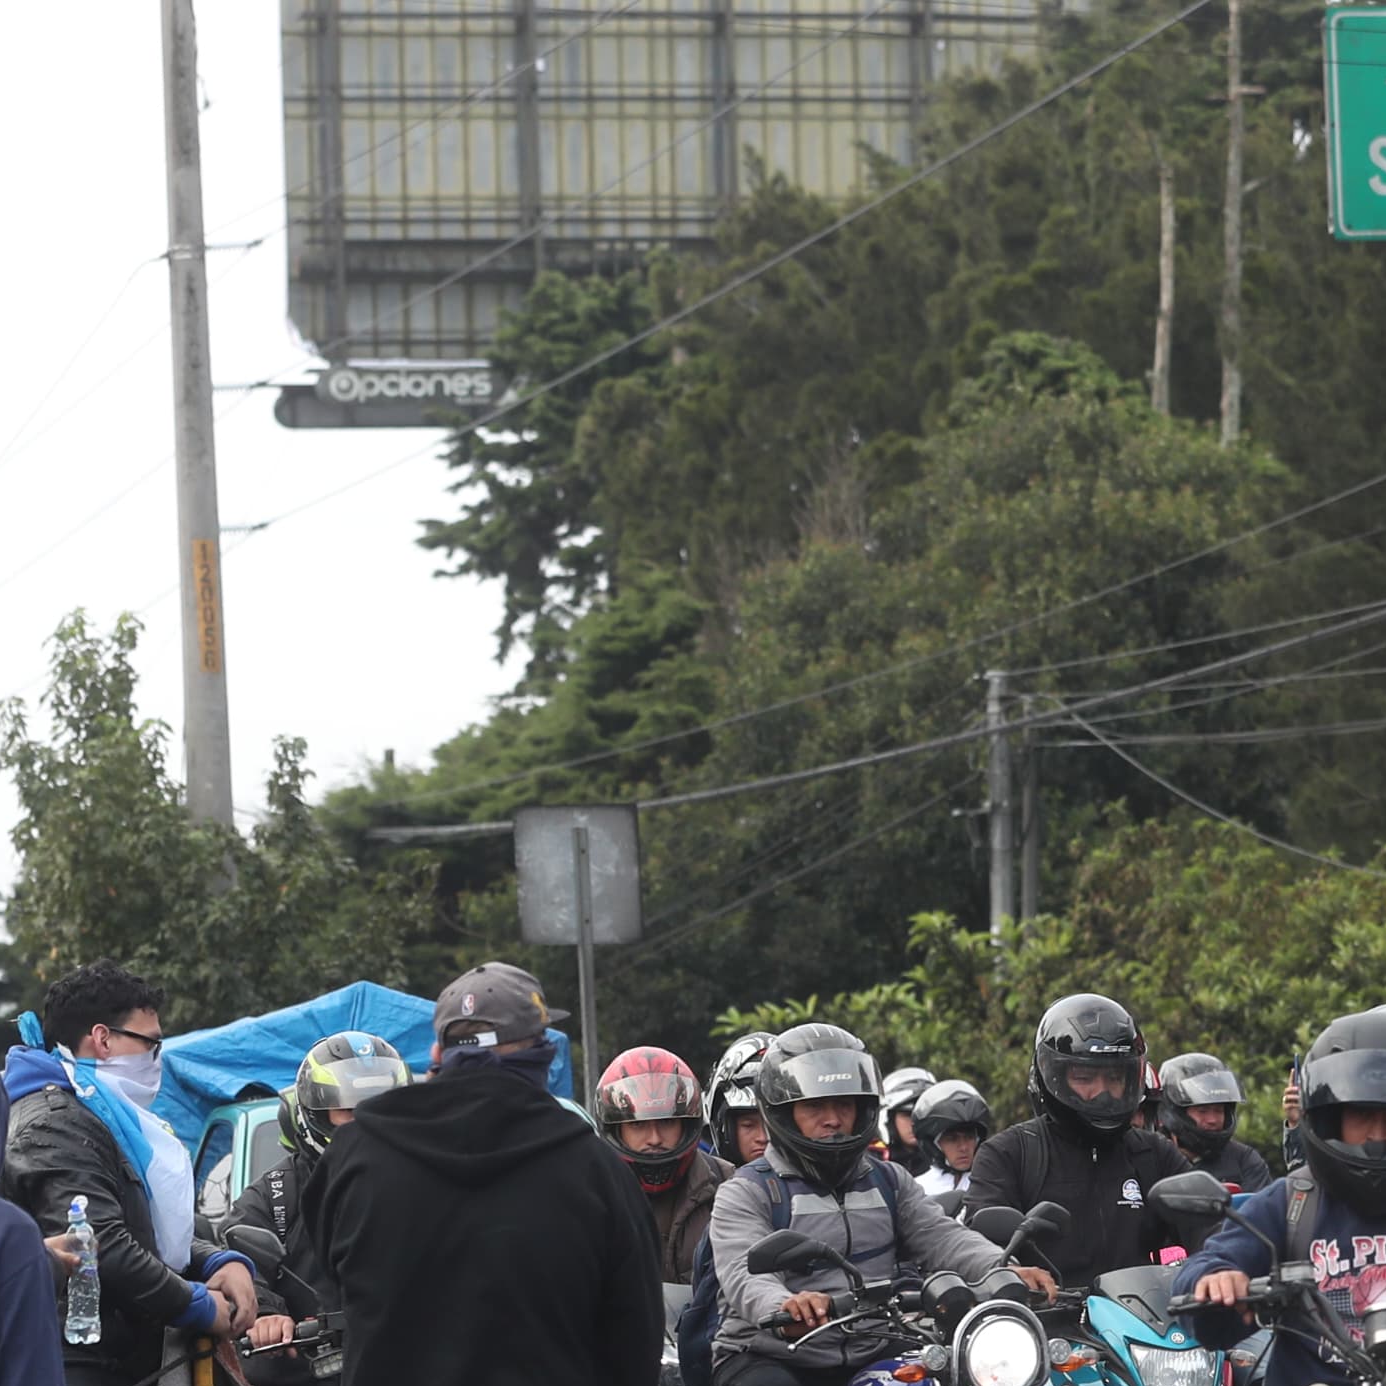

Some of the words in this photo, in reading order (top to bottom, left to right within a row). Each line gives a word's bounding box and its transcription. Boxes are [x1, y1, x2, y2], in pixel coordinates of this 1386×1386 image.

[329, 368, 494, 404] Opciones
[1089, 1045, 1132, 1053] LS2
[1309, 1238, 1351, 1283] St.
